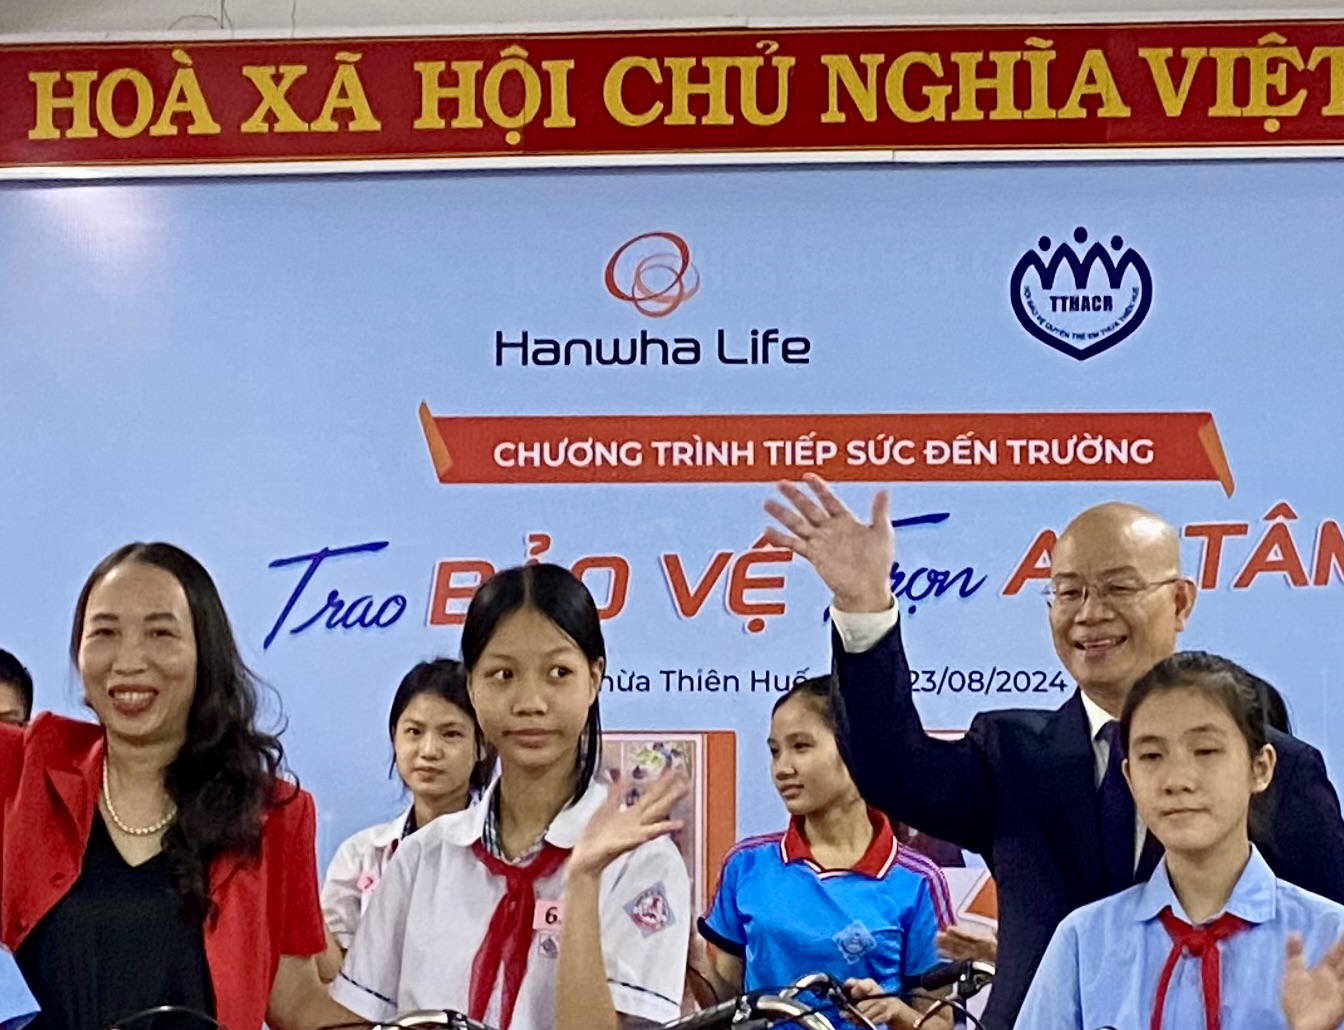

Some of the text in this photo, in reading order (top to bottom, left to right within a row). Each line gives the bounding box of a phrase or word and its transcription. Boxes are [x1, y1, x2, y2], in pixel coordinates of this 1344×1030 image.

[28, 48, 222, 140] HOÀ
[241, 51, 382, 133] XÃ
[413, 44, 575, 146] HỘI
[603, 40, 796, 128] CHỦ
[821, 36, 1132, 122] NGHĨA
[495, 328, 811, 366] Hanwha Life
[493, 431, 1154, 467] CHƯƠNG TRÌNH TIẾP SỨC ĐẾN TRƯỜNG
[263, 540, 407, 651] Trao
[659, 668, 741, 693] Thiên
